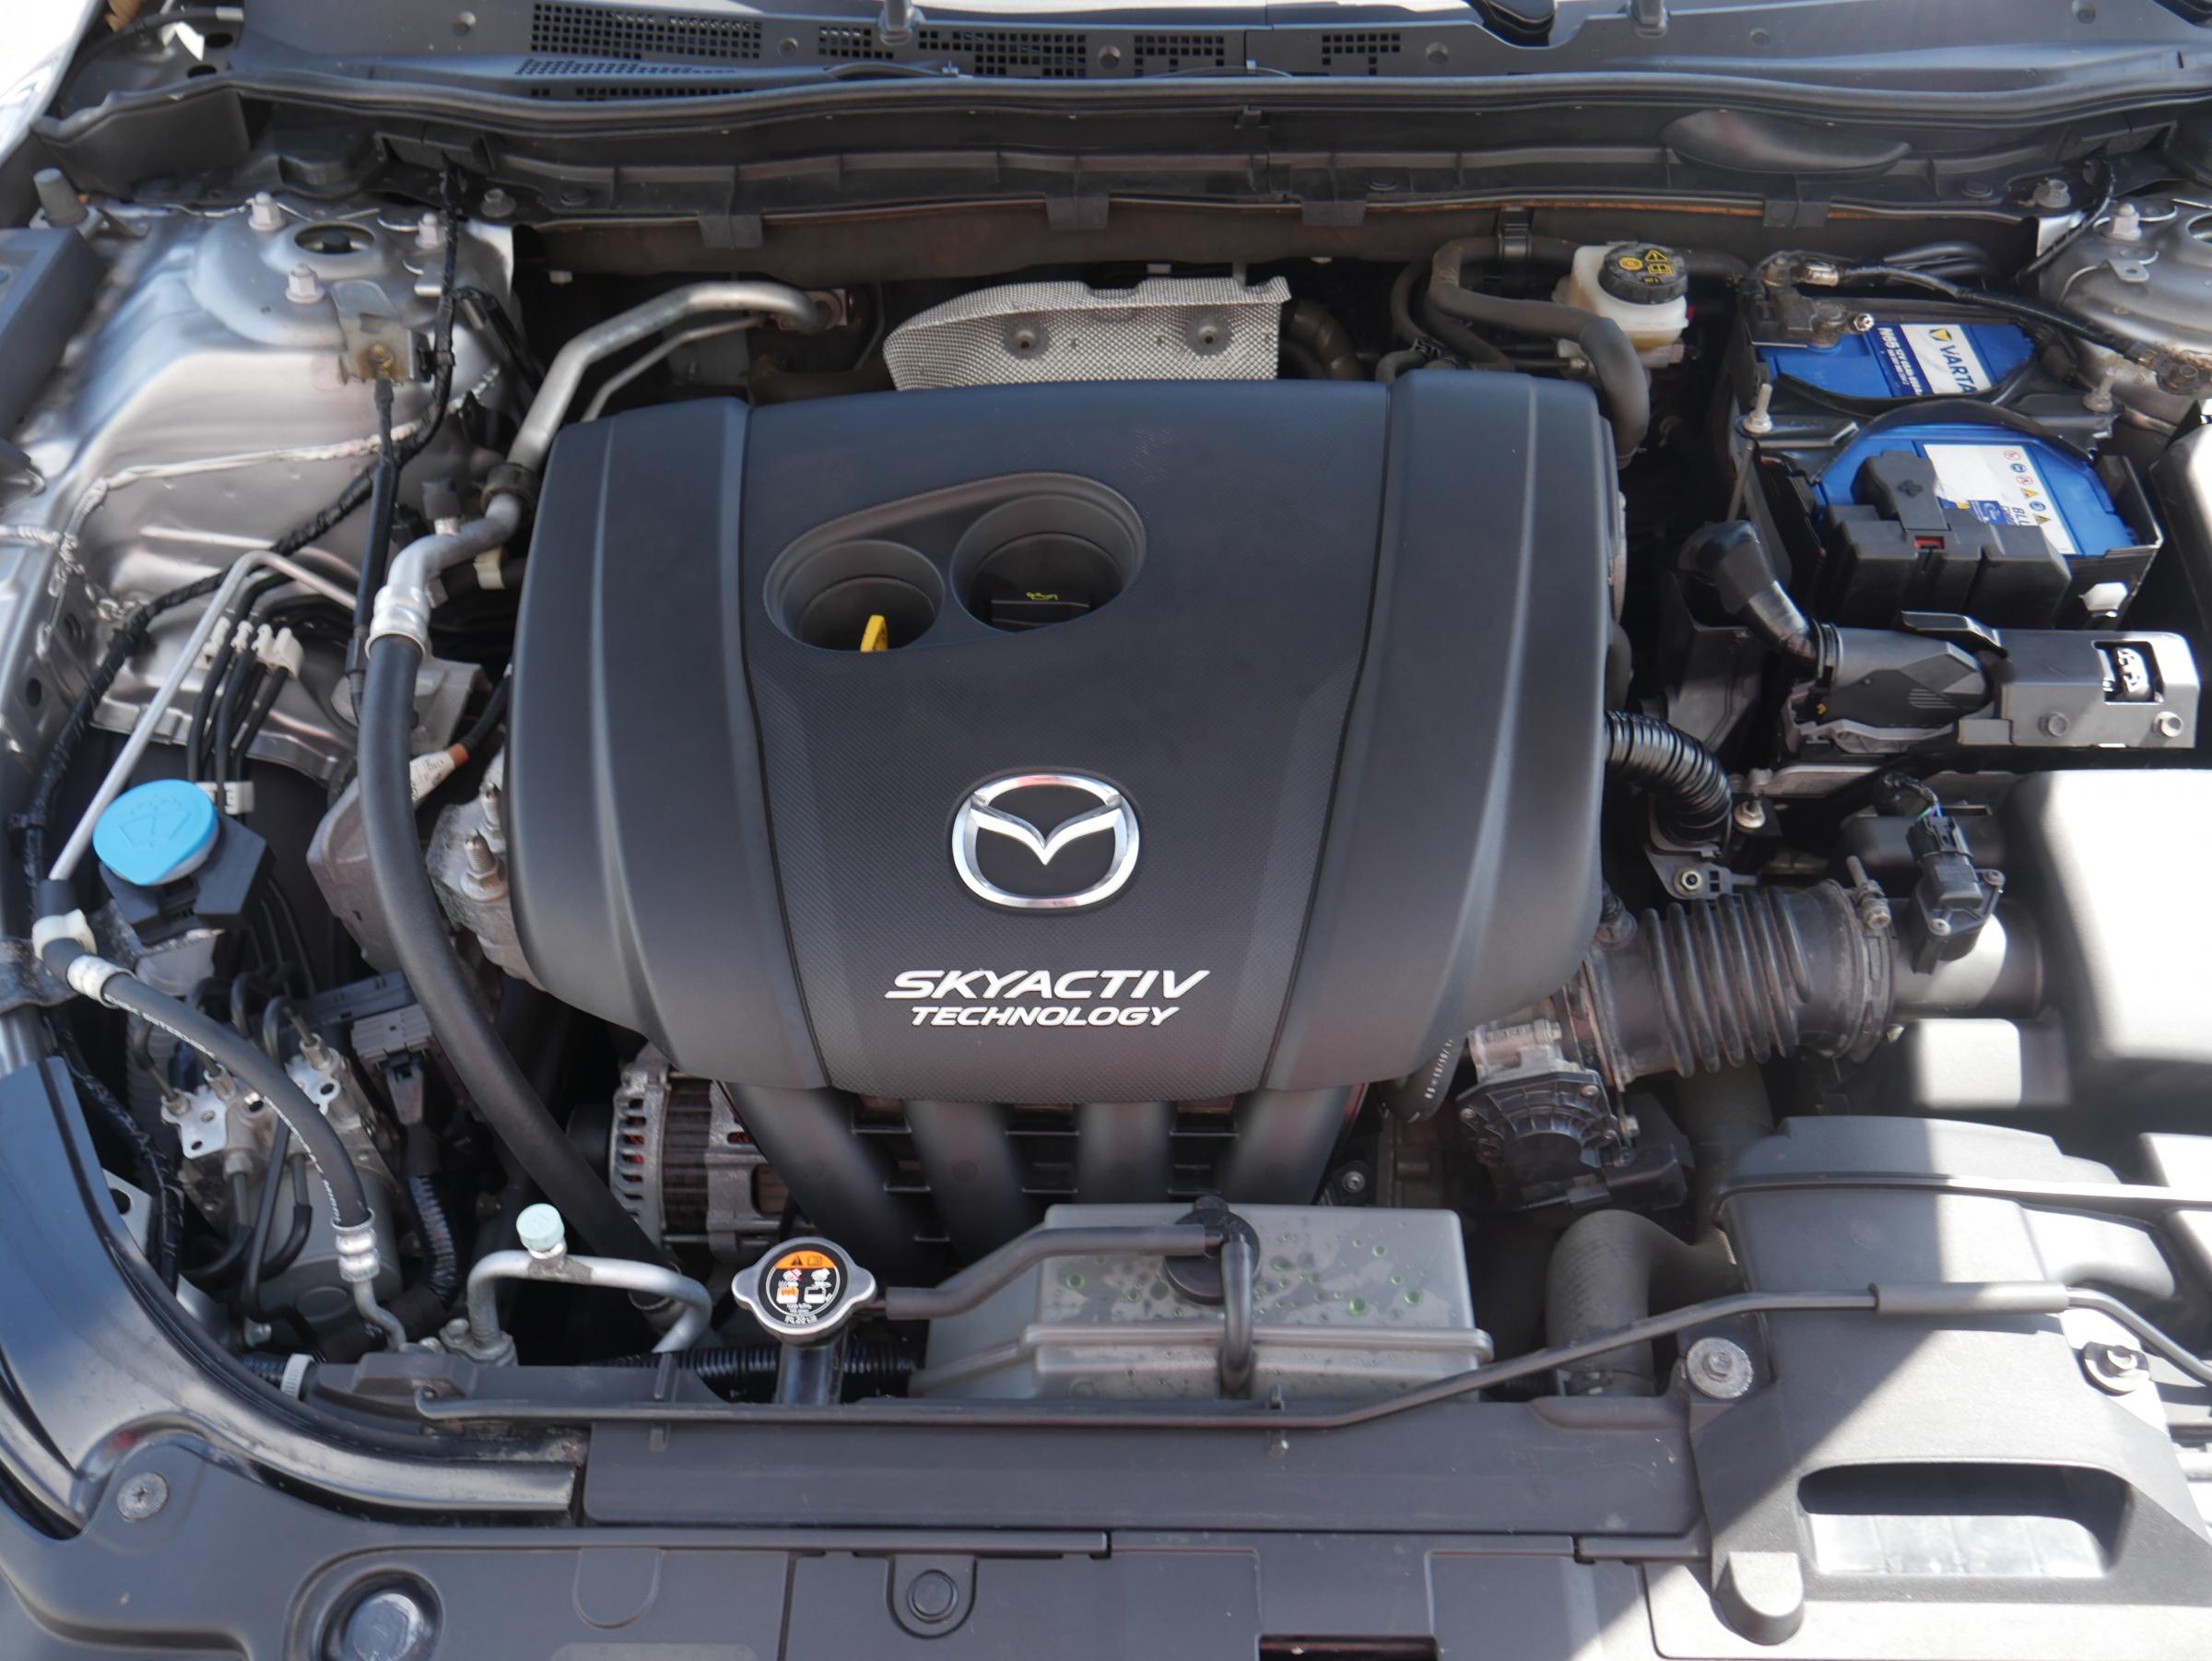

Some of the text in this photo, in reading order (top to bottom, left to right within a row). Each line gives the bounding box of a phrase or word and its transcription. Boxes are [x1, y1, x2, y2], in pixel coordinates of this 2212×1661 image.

[1940, 345, 1977, 394] VARTA
[884, 969, 1211, 999] SKYACTIV
[911, 1006, 1181, 1027] TECHNOLOGY
